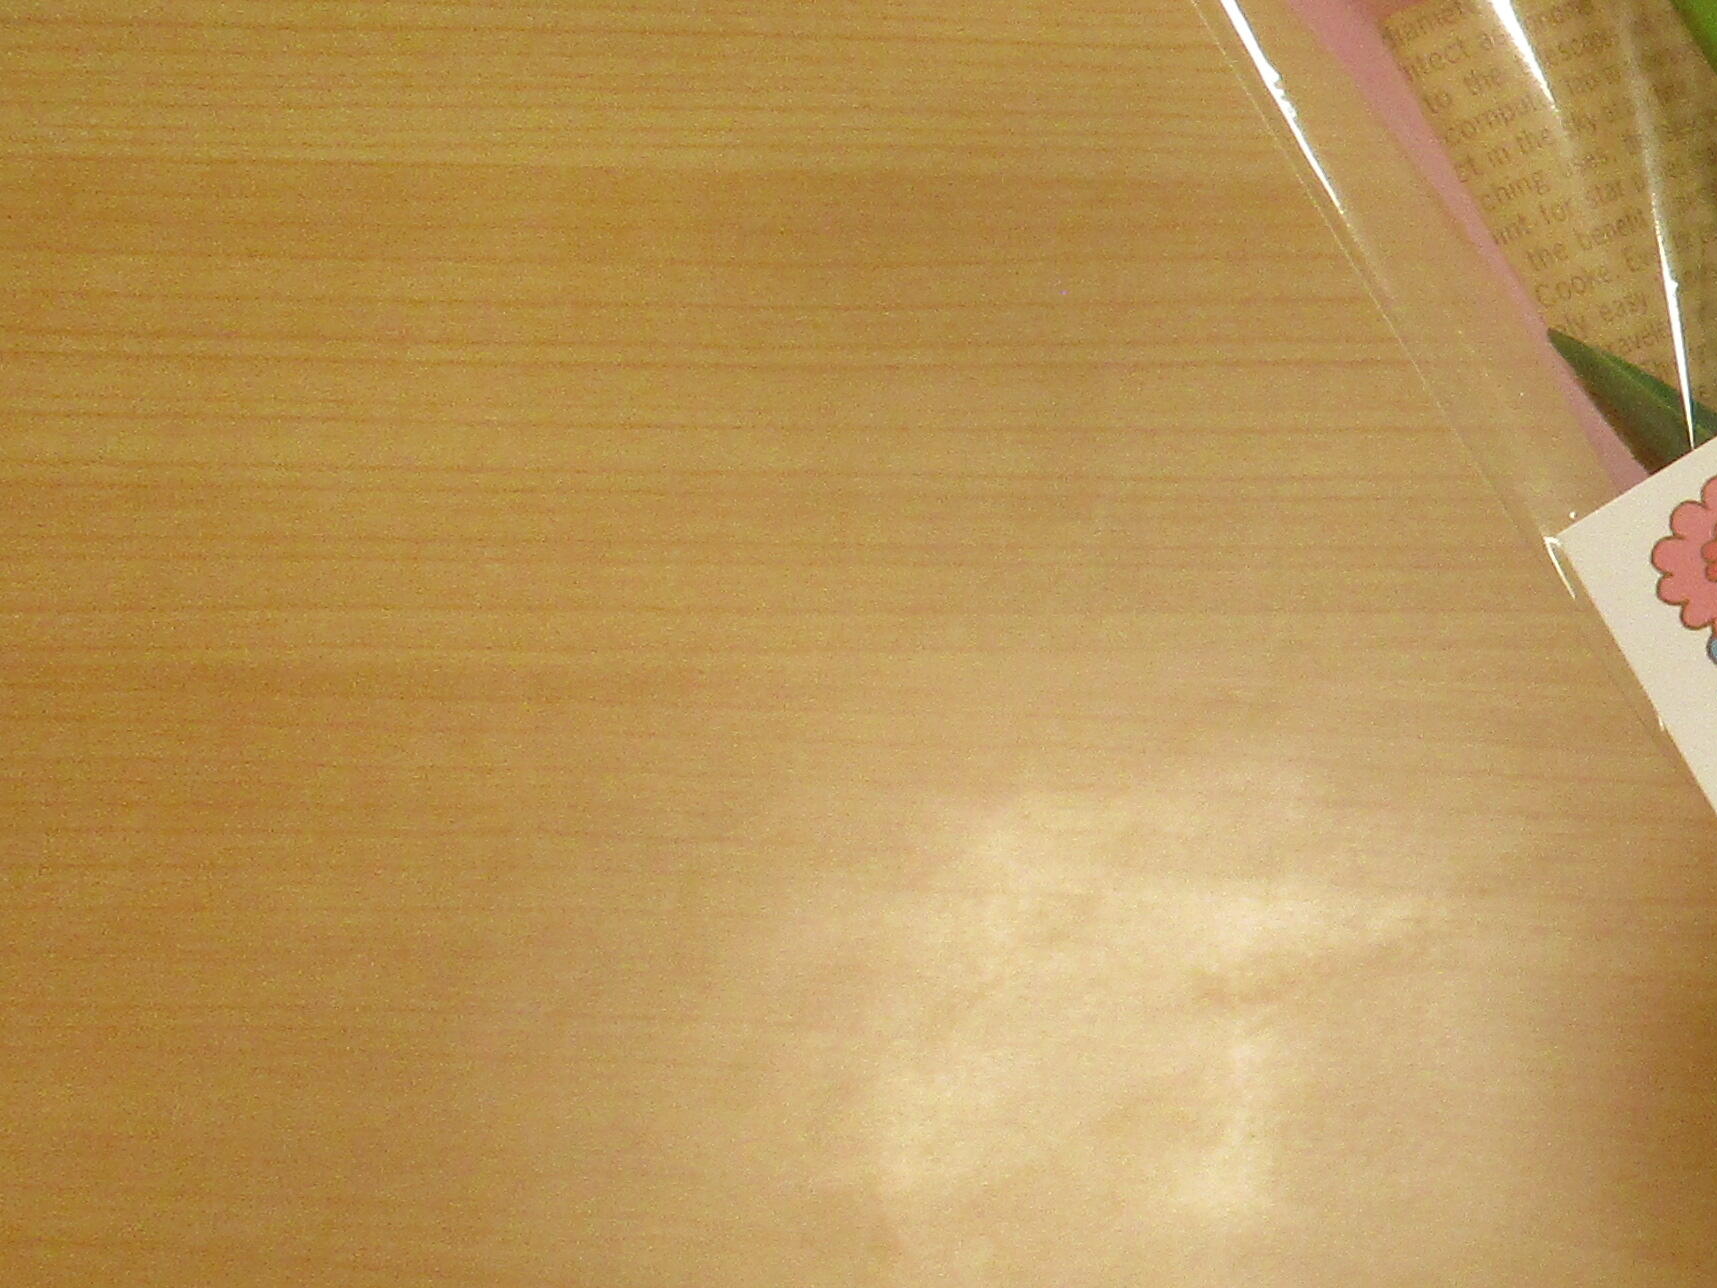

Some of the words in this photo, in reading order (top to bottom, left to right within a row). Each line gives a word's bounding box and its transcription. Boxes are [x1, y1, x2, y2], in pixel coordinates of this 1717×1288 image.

[1423, 87, 1454, 115] to
[1462, 63, 1504, 96] the
[1515, 123, 1553, 155] the
[1526, 239, 1569, 273] the
[1533, 257, 1623, 311] Cooke.
